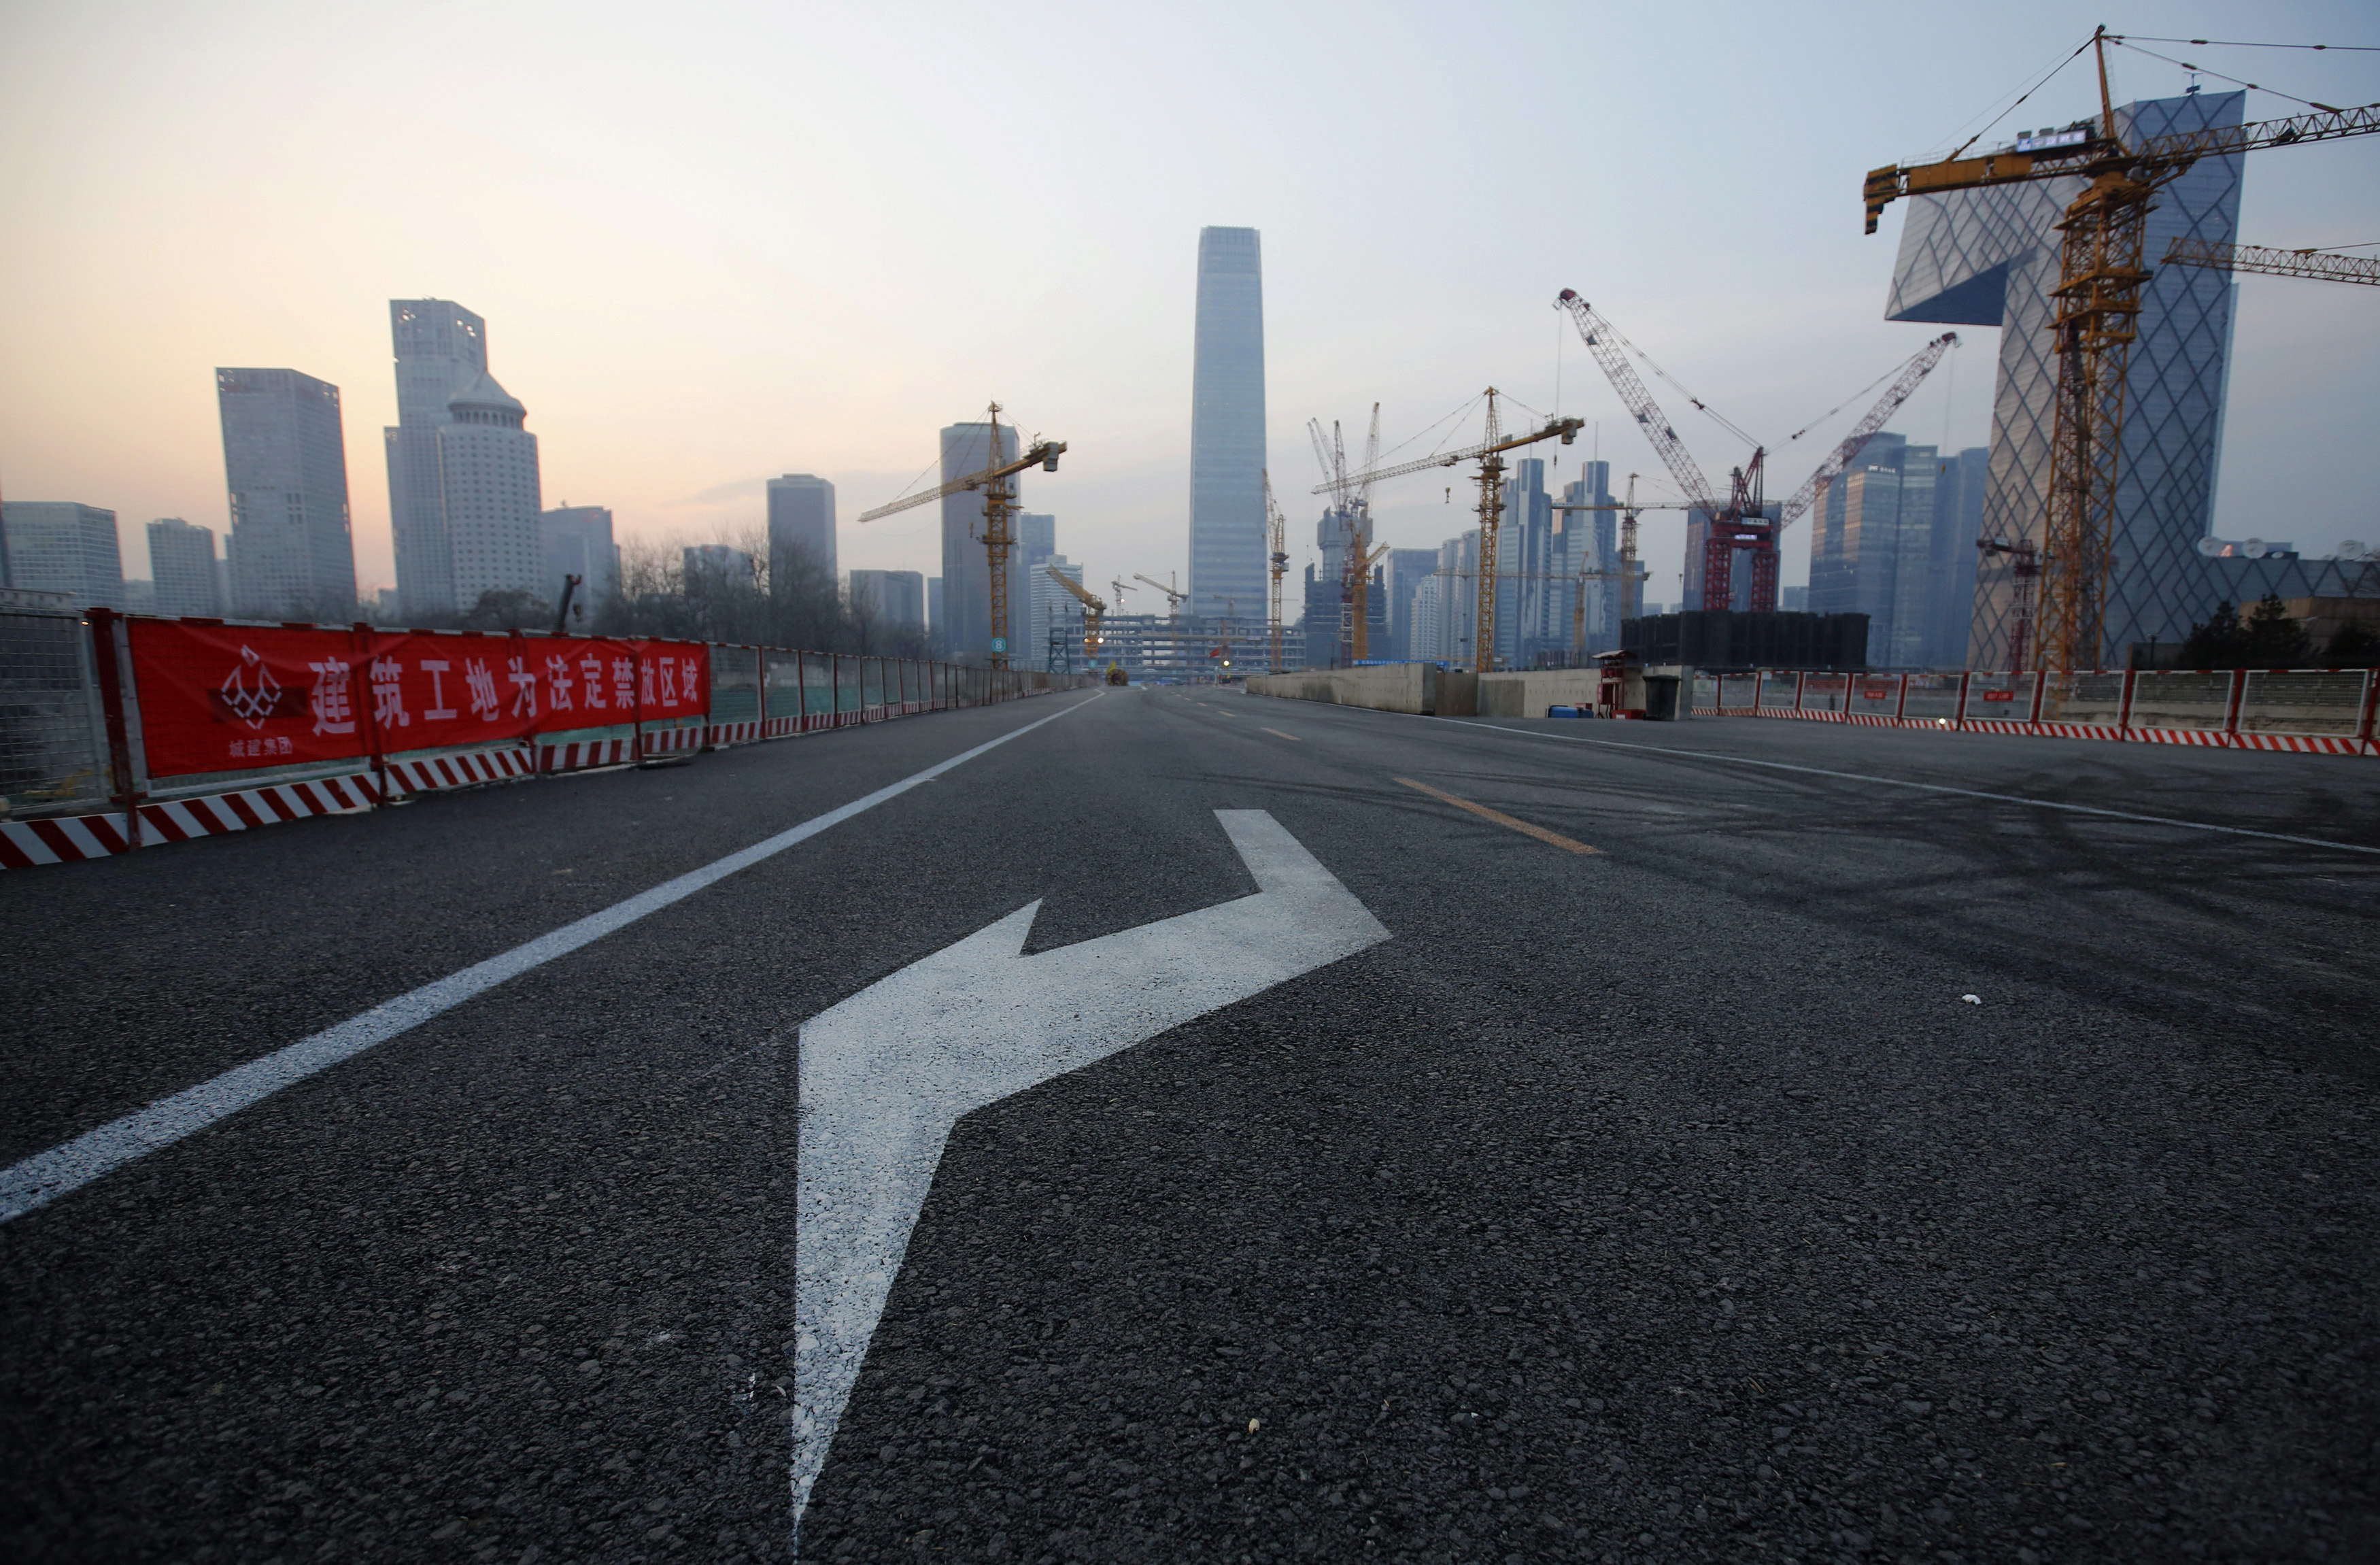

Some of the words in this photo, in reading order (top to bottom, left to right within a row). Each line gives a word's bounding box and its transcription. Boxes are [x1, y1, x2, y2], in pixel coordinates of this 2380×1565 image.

[995, 640, 1002, 650] 8
[308, 653, 698, 737] 建筑工地为法定禁放区域
[229, 737, 293, 757] 城建集团
